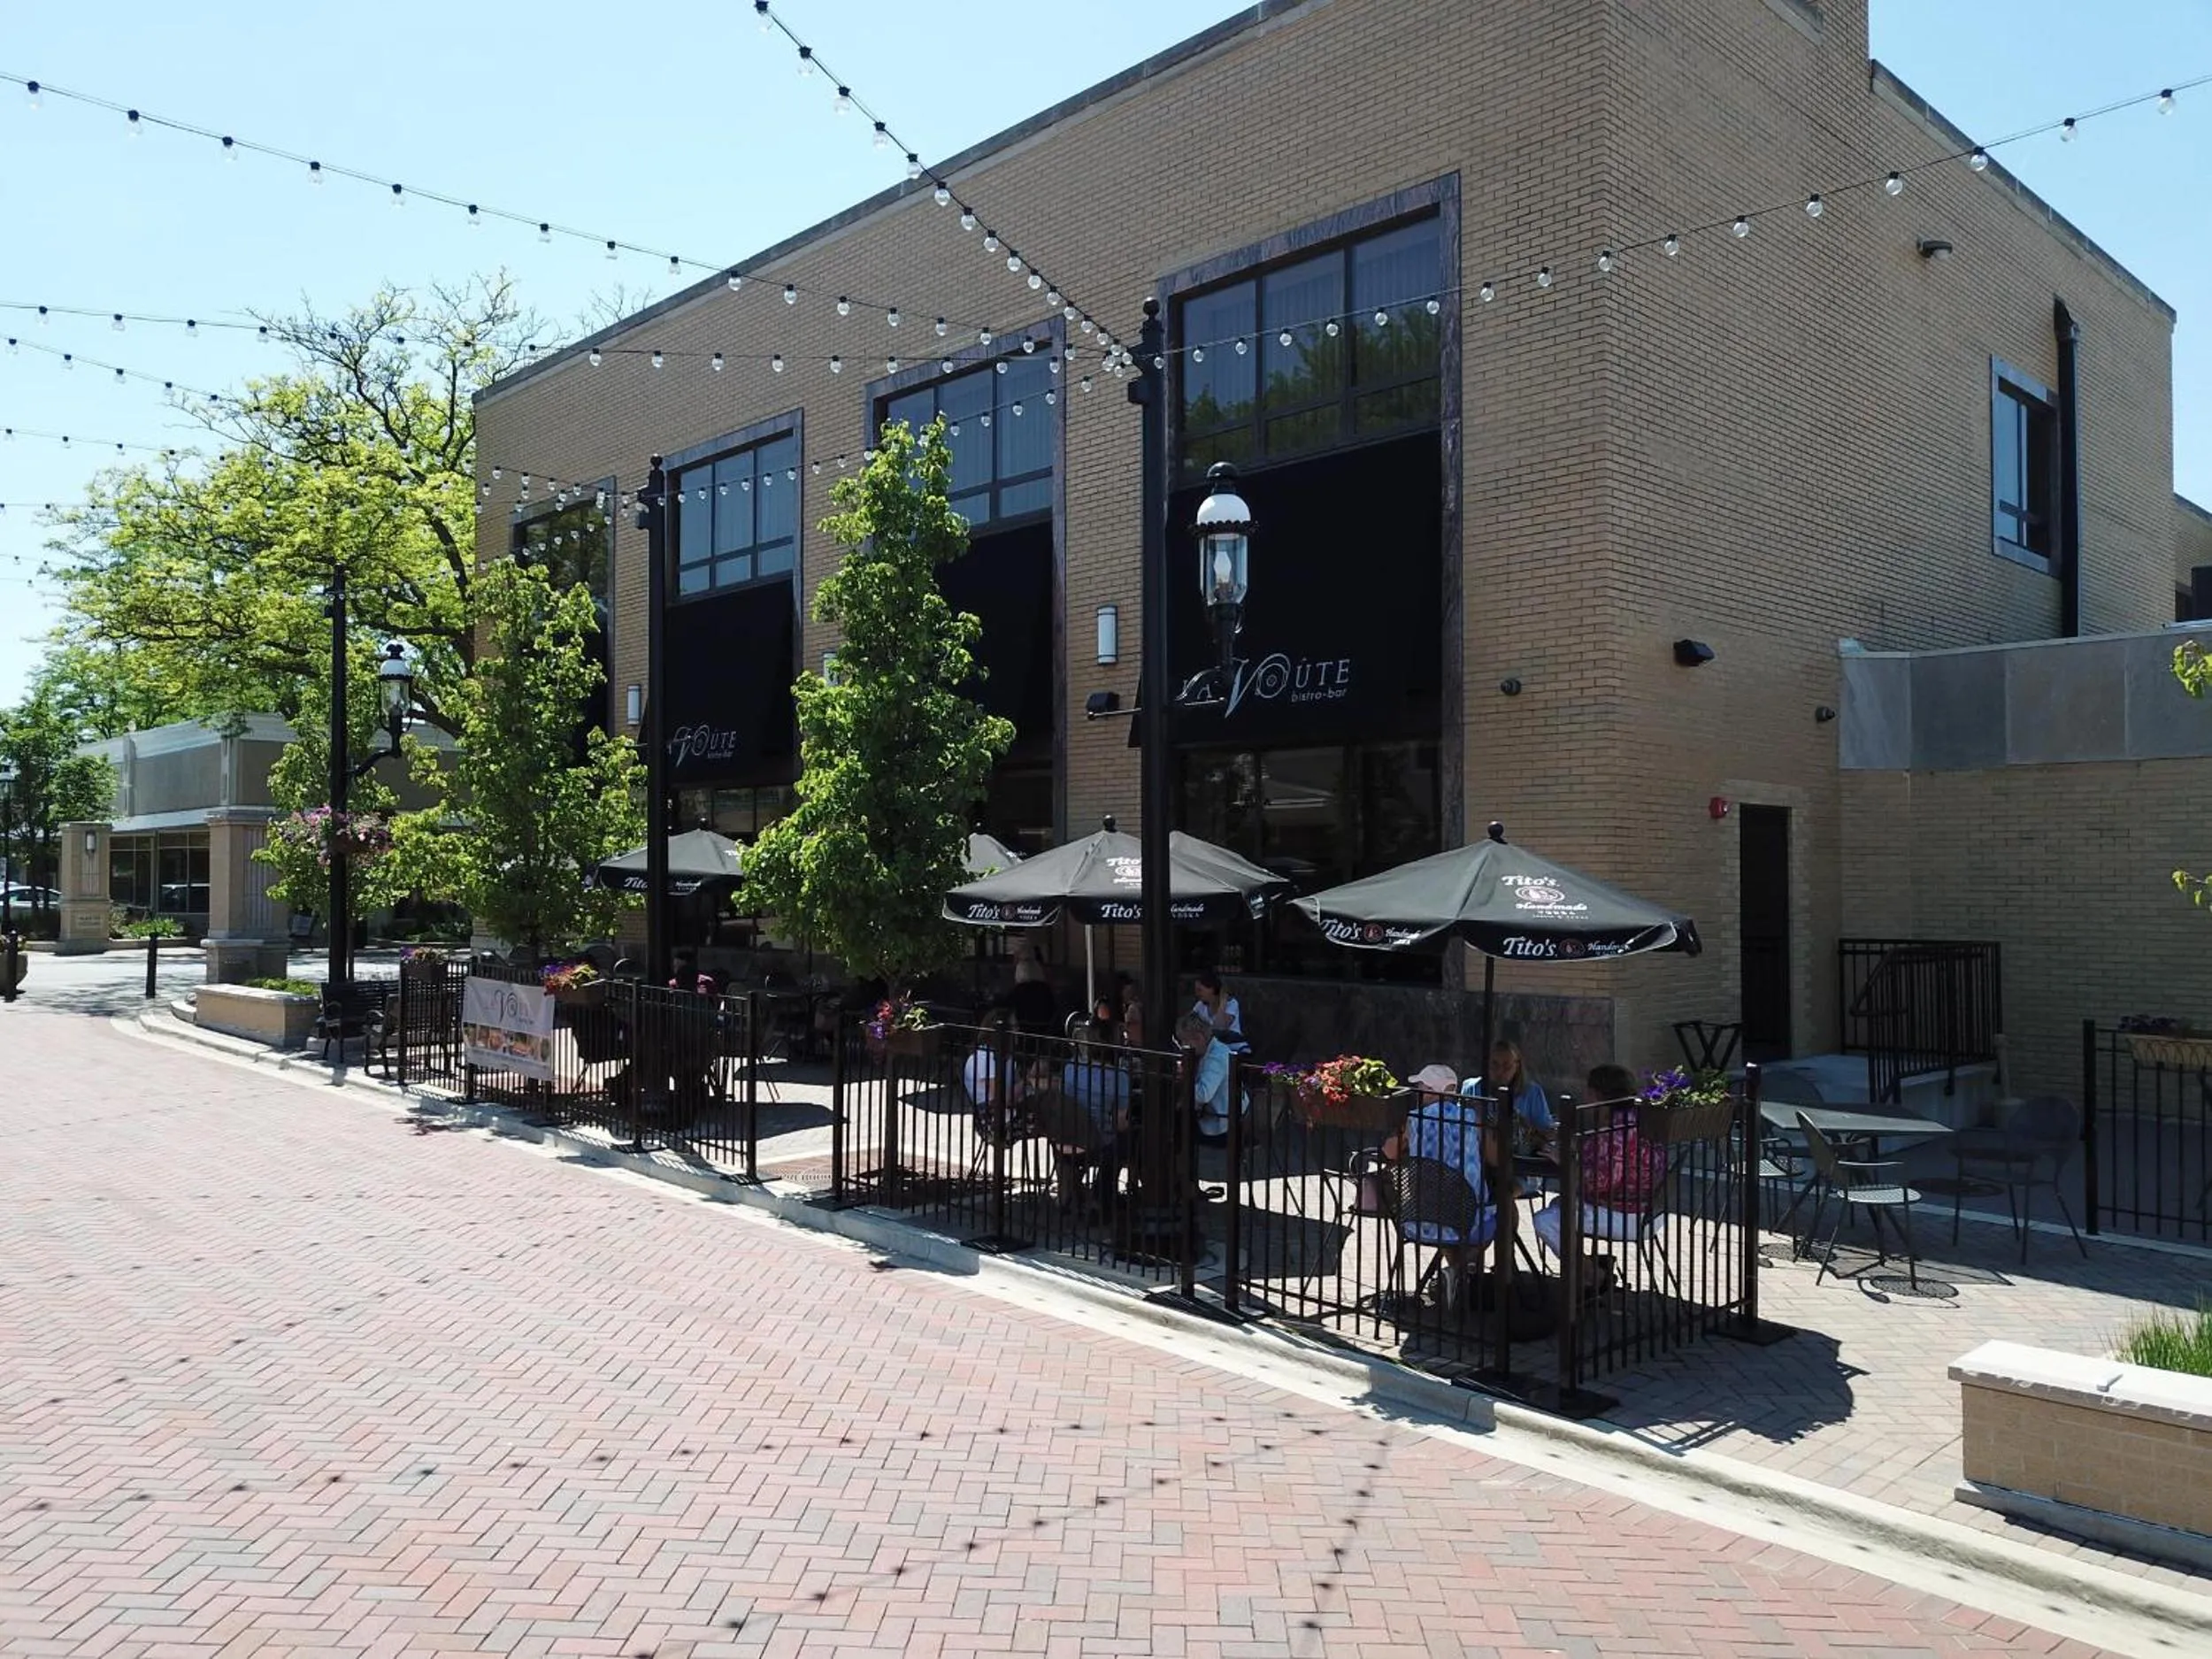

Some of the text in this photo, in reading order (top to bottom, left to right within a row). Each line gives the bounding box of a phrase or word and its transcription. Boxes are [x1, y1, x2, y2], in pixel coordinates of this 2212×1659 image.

[967, 902, 1001, 920] Tito's
[1320, 918, 1363, 941] Tito's
[1502, 935, 1558, 957] Tito's
